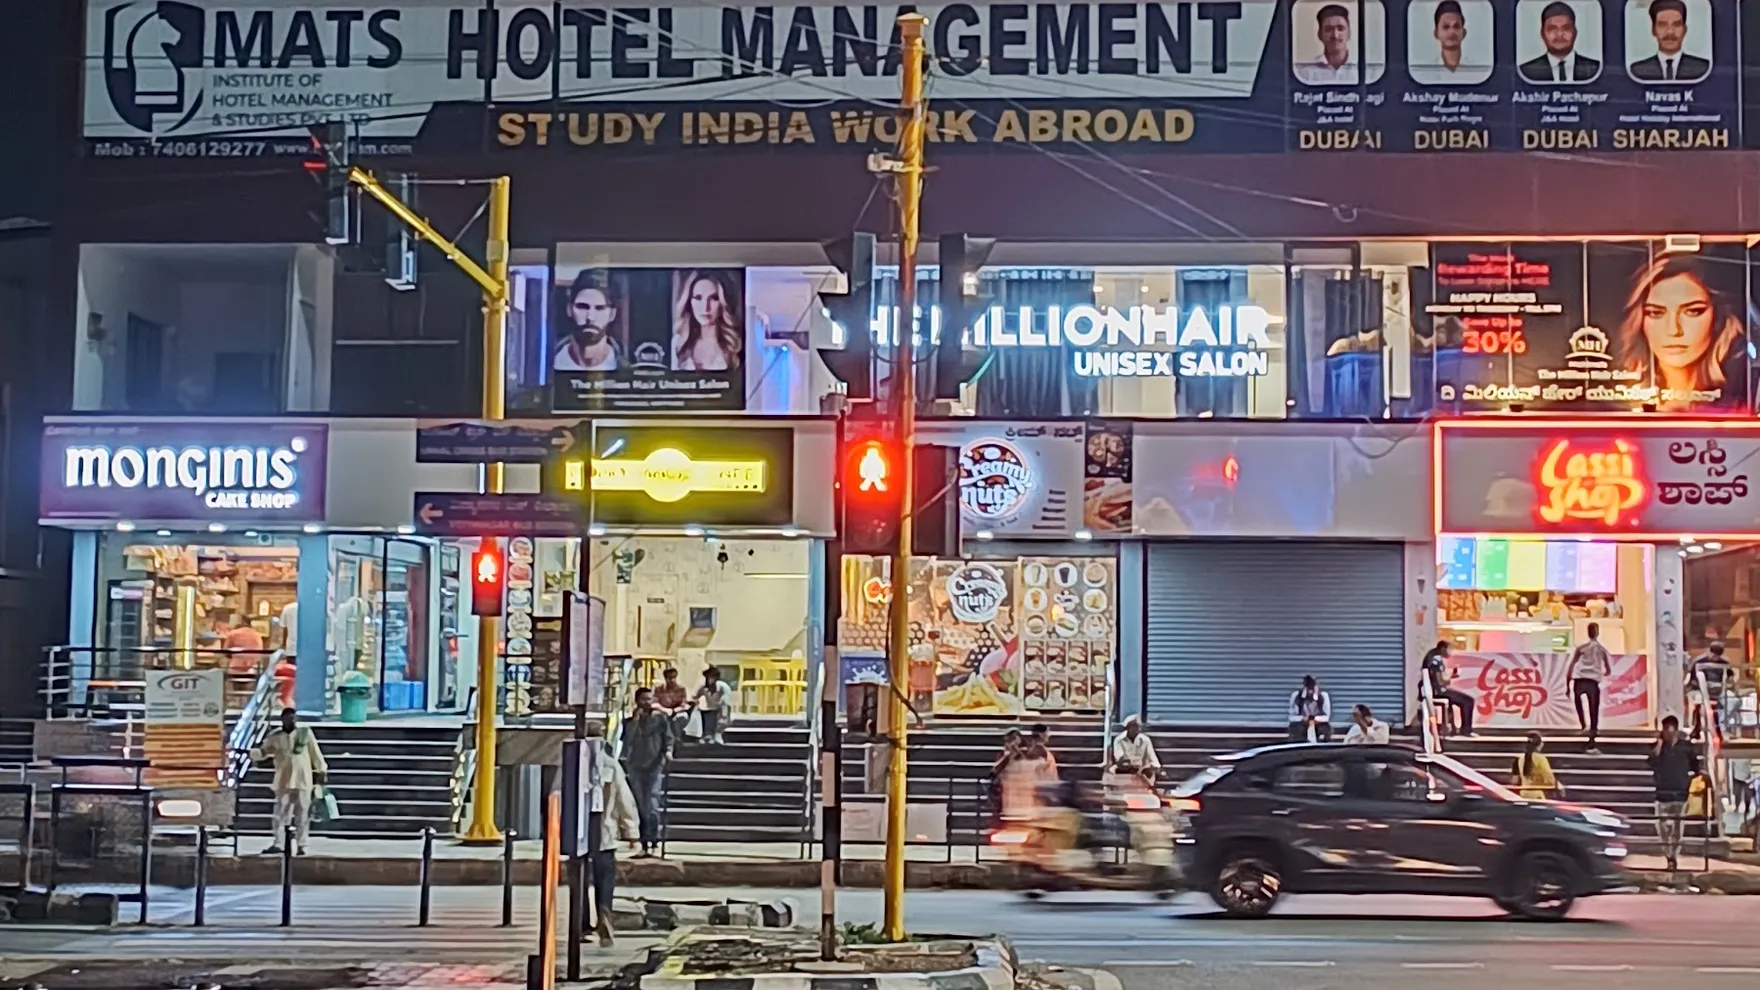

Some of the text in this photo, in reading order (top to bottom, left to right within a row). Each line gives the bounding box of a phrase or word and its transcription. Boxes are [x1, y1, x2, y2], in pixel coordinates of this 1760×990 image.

[213, 10, 402, 68] MATS
[446, 3, 1242, 80] HOTEL MANAGEMENT
[213, 74, 323, 87] INSTITUTE OF
[212, 93, 393, 107] HOTEL MANAGEMENT
[1684, 90, 1694, 102] K
[226, 112, 294, 126] STUDIES
[497, 112, 666, 145] STUDY
[682, 111, 815, 145] INDIA
[992, 108, 1195, 142] ABROAD
[1300, 130, 1382, 149] DUBAI
[1414, 129, 1489, 149] DUBAI
[1523, 129, 1598, 149] DUBAI
[1613, 128, 1730, 149] SHARJAH
[94, 143, 134, 156] Mob
[1462, 331, 1527, 354] 30%
[1074, 352, 1268, 376] UNISEX SALON
[1541, 438, 1634, 490] Lassi
[204, 491, 299, 509] CAKE SHOP
[961, 483, 1018, 513] nuts
[1656, 475, 1749, 506] ಶಾಪ್
[170, 678, 200, 690] GIT
[1476, 658, 1542, 691] Lassi
